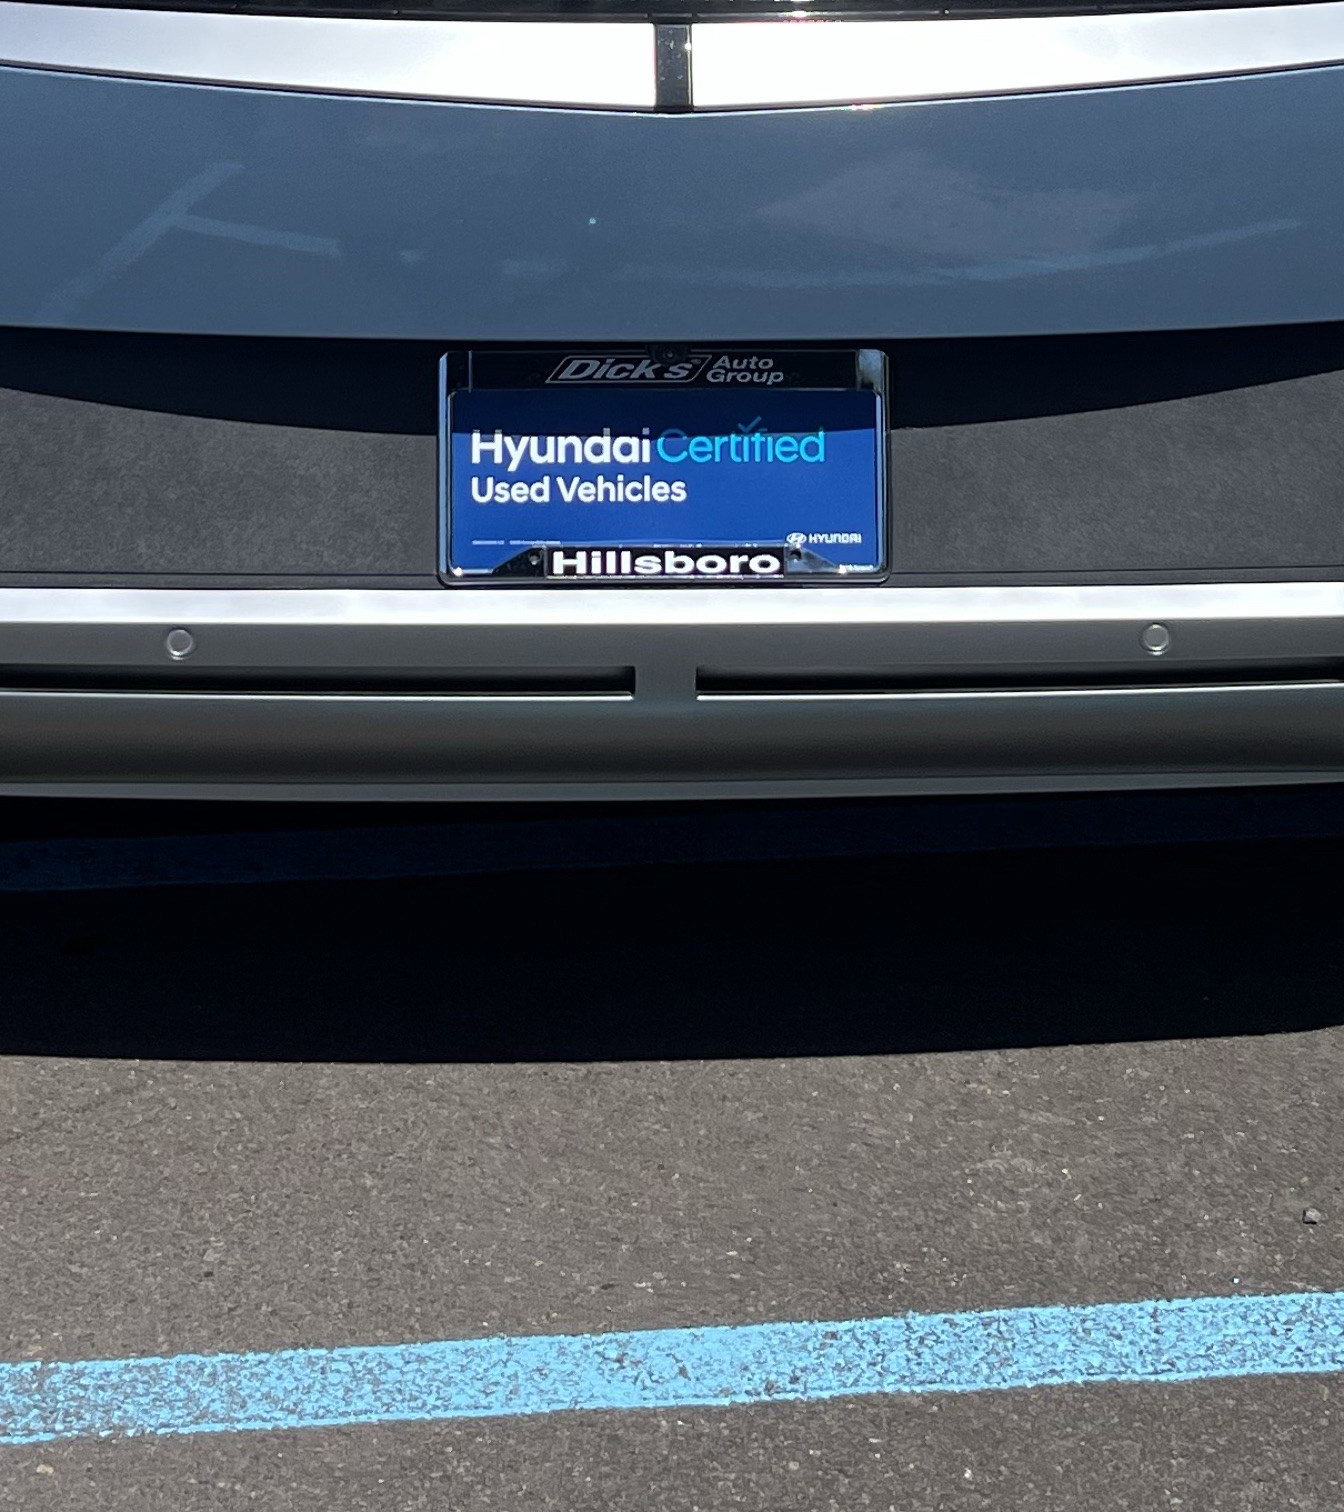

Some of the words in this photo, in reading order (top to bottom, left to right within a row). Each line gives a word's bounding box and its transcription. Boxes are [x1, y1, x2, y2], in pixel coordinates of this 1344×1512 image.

[558, 358, 693, 380] Dicks
[712, 355, 774, 370] Auto
[706, 368, 784, 385] Group
[471, 428, 651, 472] Hyundai
[657, 426, 825, 463] Certified
[471, 476, 550, 503] Used
[556, 475, 687, 503] Vehicles
[808, 532, 862, 544] HYUNDAI
[552, 550, 782, 576] Hillsboro
